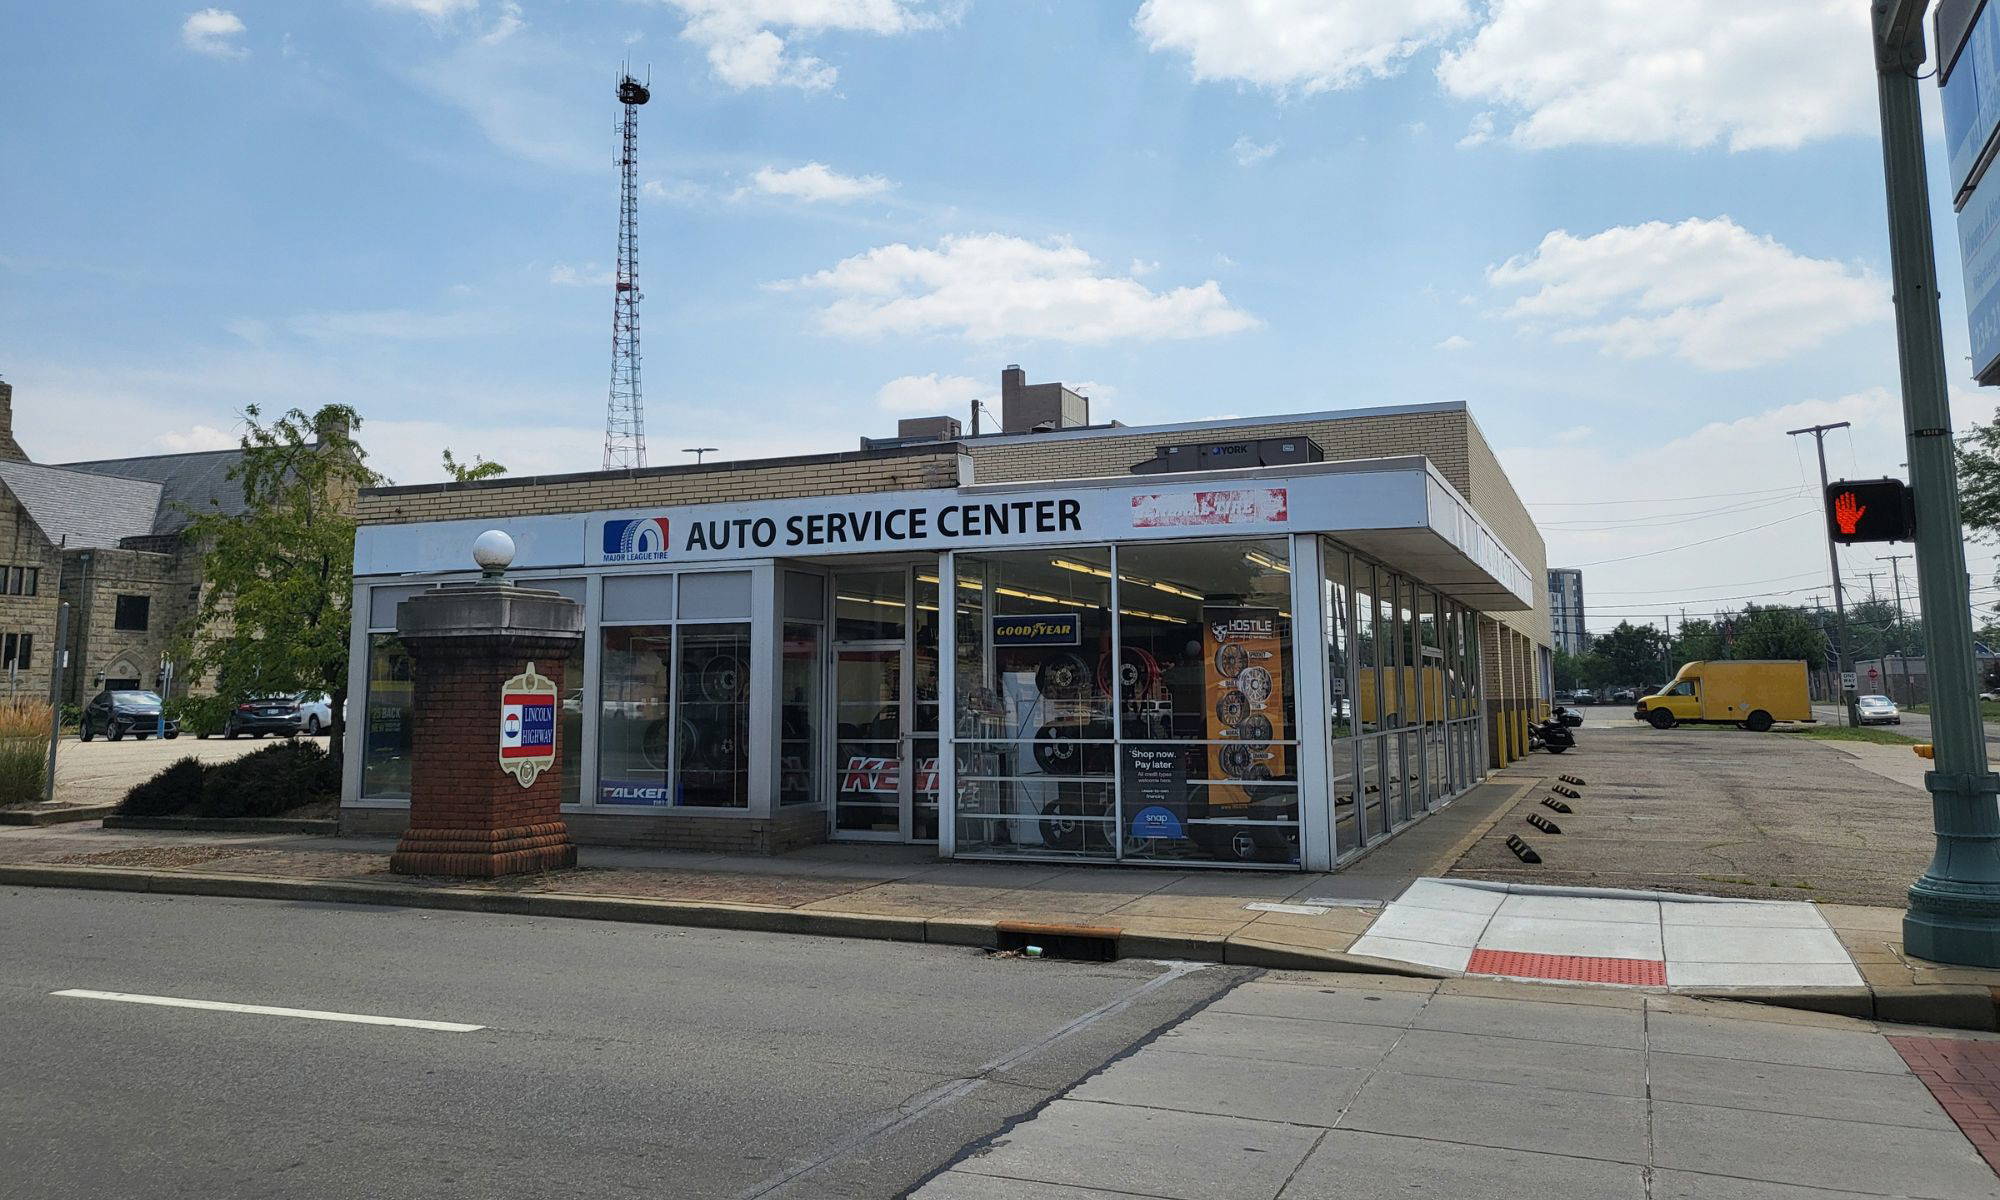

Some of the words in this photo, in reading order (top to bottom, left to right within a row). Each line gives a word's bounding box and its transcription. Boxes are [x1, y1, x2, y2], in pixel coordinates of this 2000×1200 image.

[1222, 444, 1247, 455] YORK
[686, 518, 777, 551] AUTO
[786, 508, 927, 546] SERVICE
[937, 500, 1082, 537] CENTER
[603, 554, 626, 562] MAJOR
[626, 552, 653, 561] LEAGUE
[653, 551, 669, 560] TIRE
[997, 623, 1071, 638] GOODYEAR
[1229, 619, 1272, 632] HOSTILE
[382, 706, 400, 719] BACK
[524, 707, 552, 722] LINCOLN
[522, 729, 553, 744] HIGHWAY
[1131, 749, 1155, 760] Shop
[1156, 751, 1177, 759] now.
[1135, 760, 1151, 770] Pay
[1152, 760, 1174, 769] later.
[1146, 813, 1168, 824] snap
